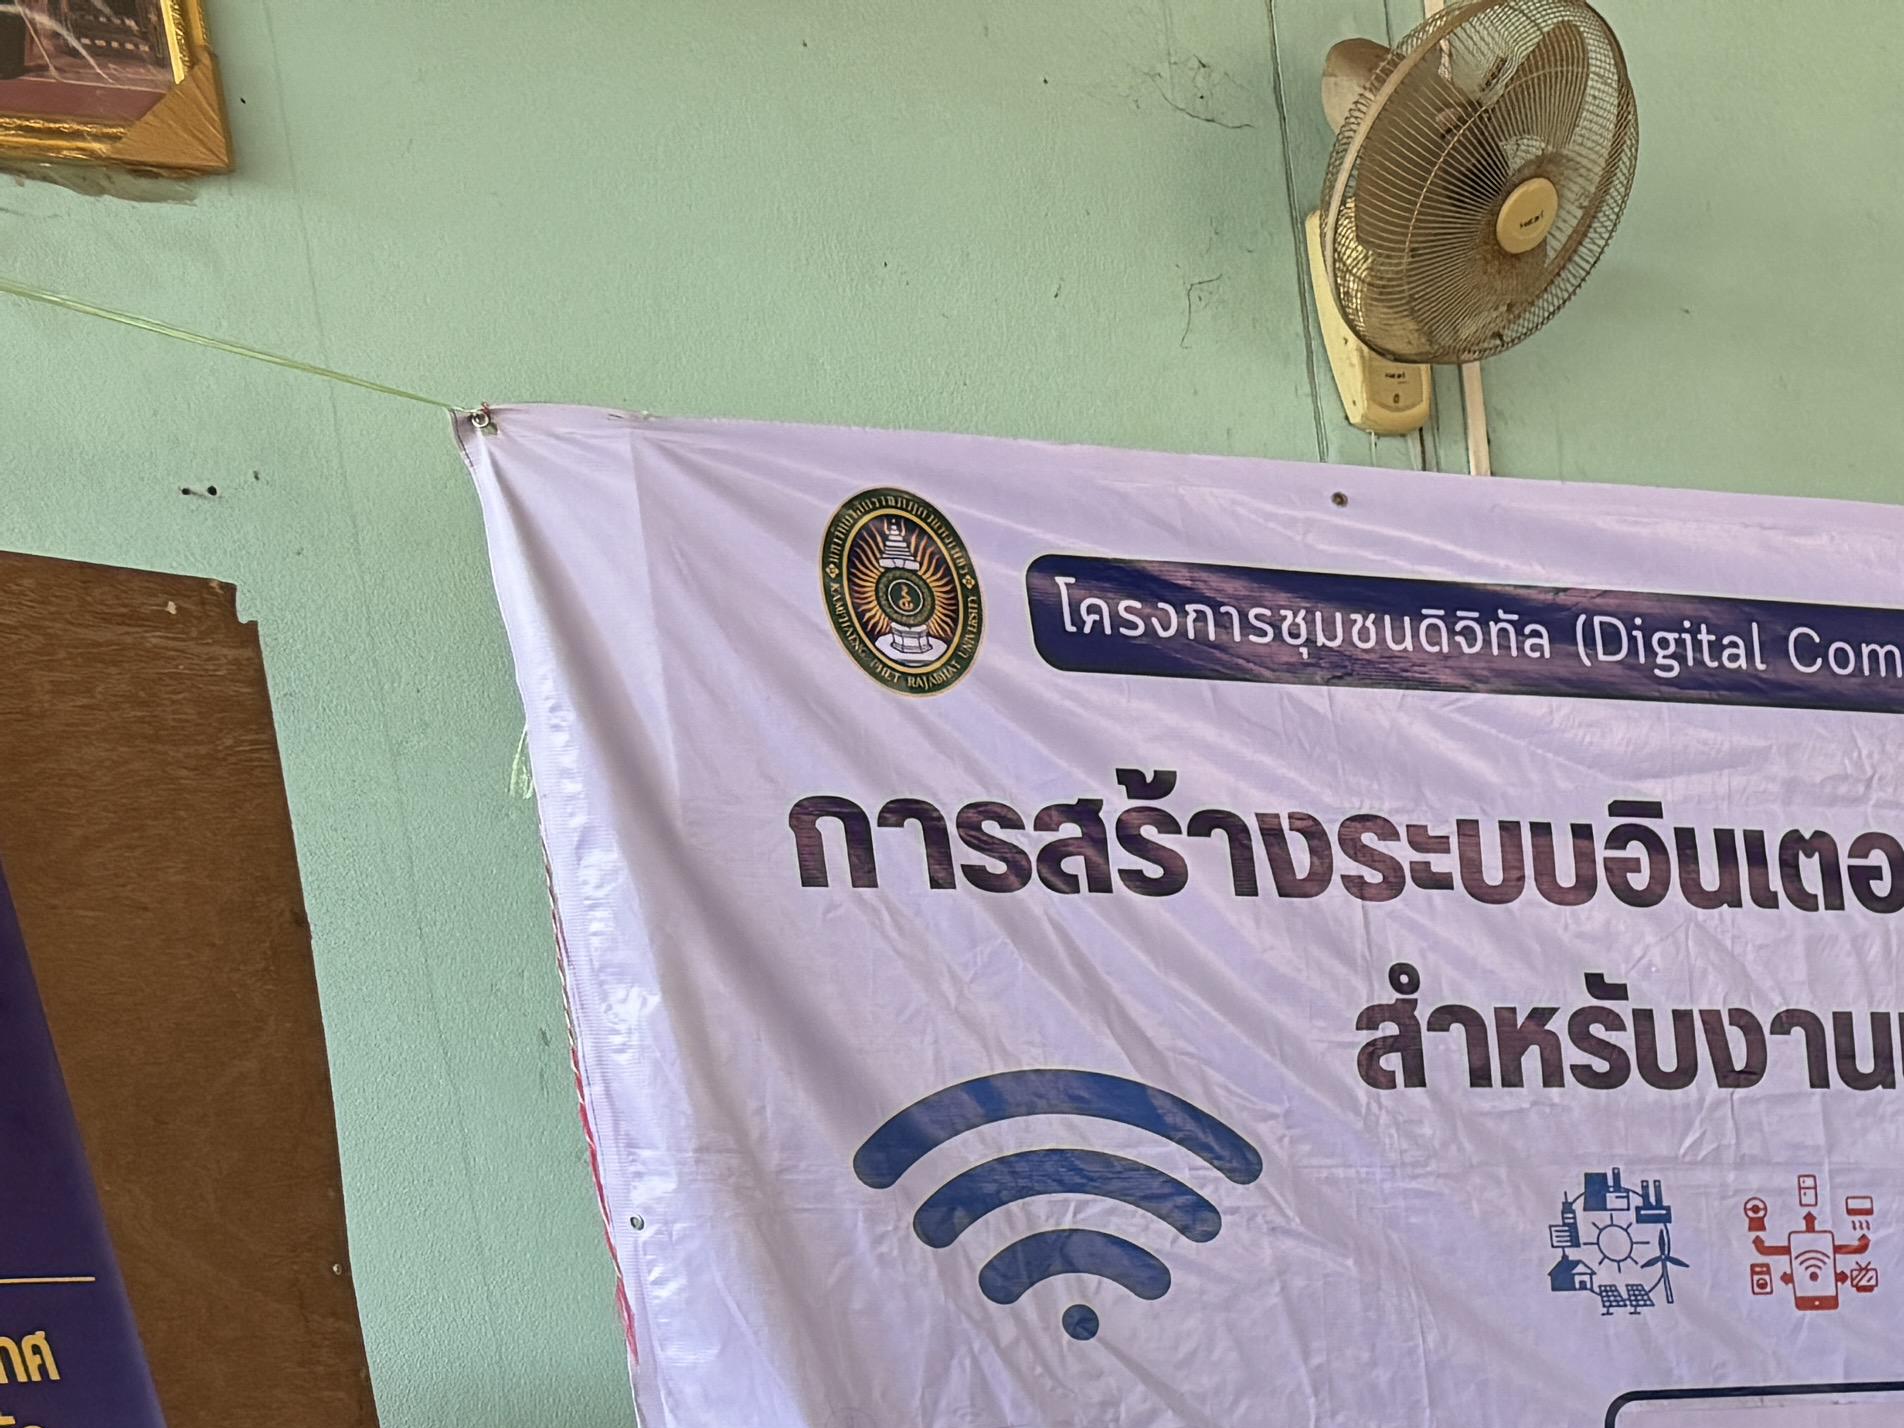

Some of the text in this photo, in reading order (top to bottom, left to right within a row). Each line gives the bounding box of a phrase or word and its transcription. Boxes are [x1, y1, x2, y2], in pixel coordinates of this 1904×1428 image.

[1055, 576, 1551, 661] โครงการชุมชนดิจิทัล
[1576, 613, 1766, 677] (Digital
